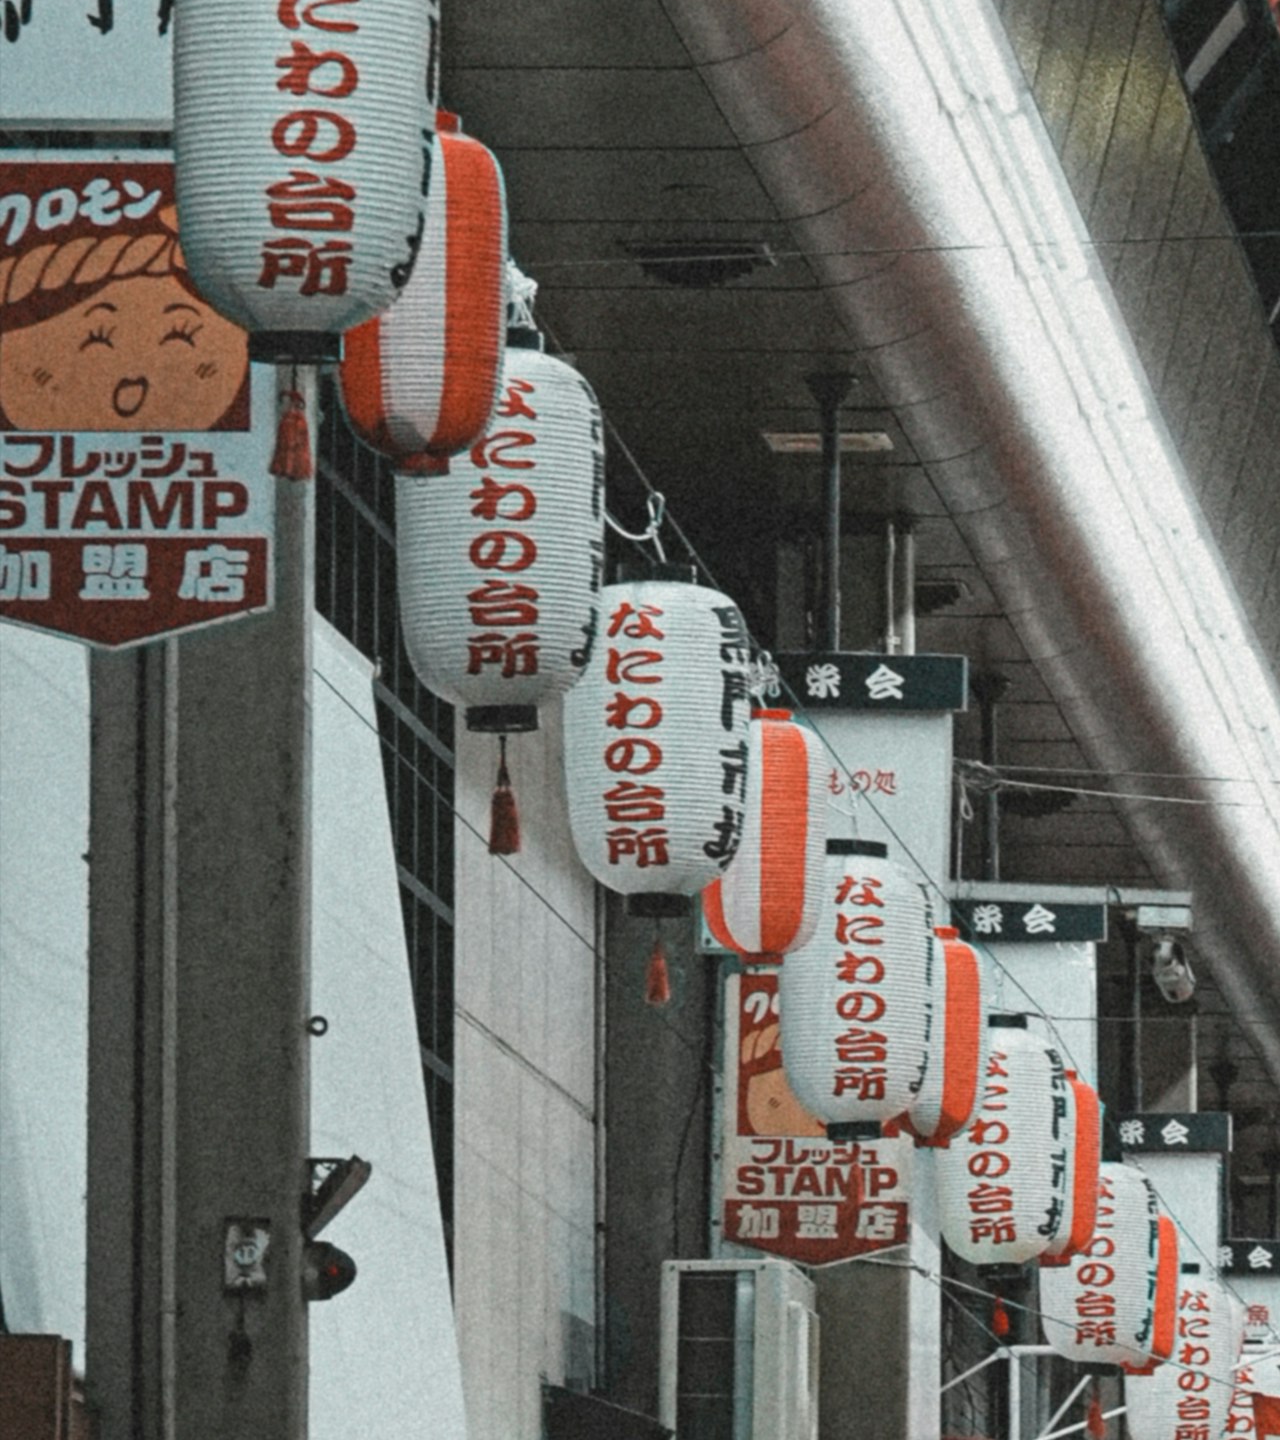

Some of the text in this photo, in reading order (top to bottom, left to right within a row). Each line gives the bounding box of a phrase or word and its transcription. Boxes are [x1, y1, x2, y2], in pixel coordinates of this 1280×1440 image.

[4, 436, 218, 478] フレッシュ
[0, 480, 249, 531] STAMP
[0, 543, 250, 602] 加盟店
[604, 601, 670, 869] なにわの台所
[834, 876, 888, 1101] なにわの台所
[751, 1139, 880, 1166] フレッシュ
[736, 1166, 898, 1197] STAMP
[736, 1201, 898, 1242] 加盟店
